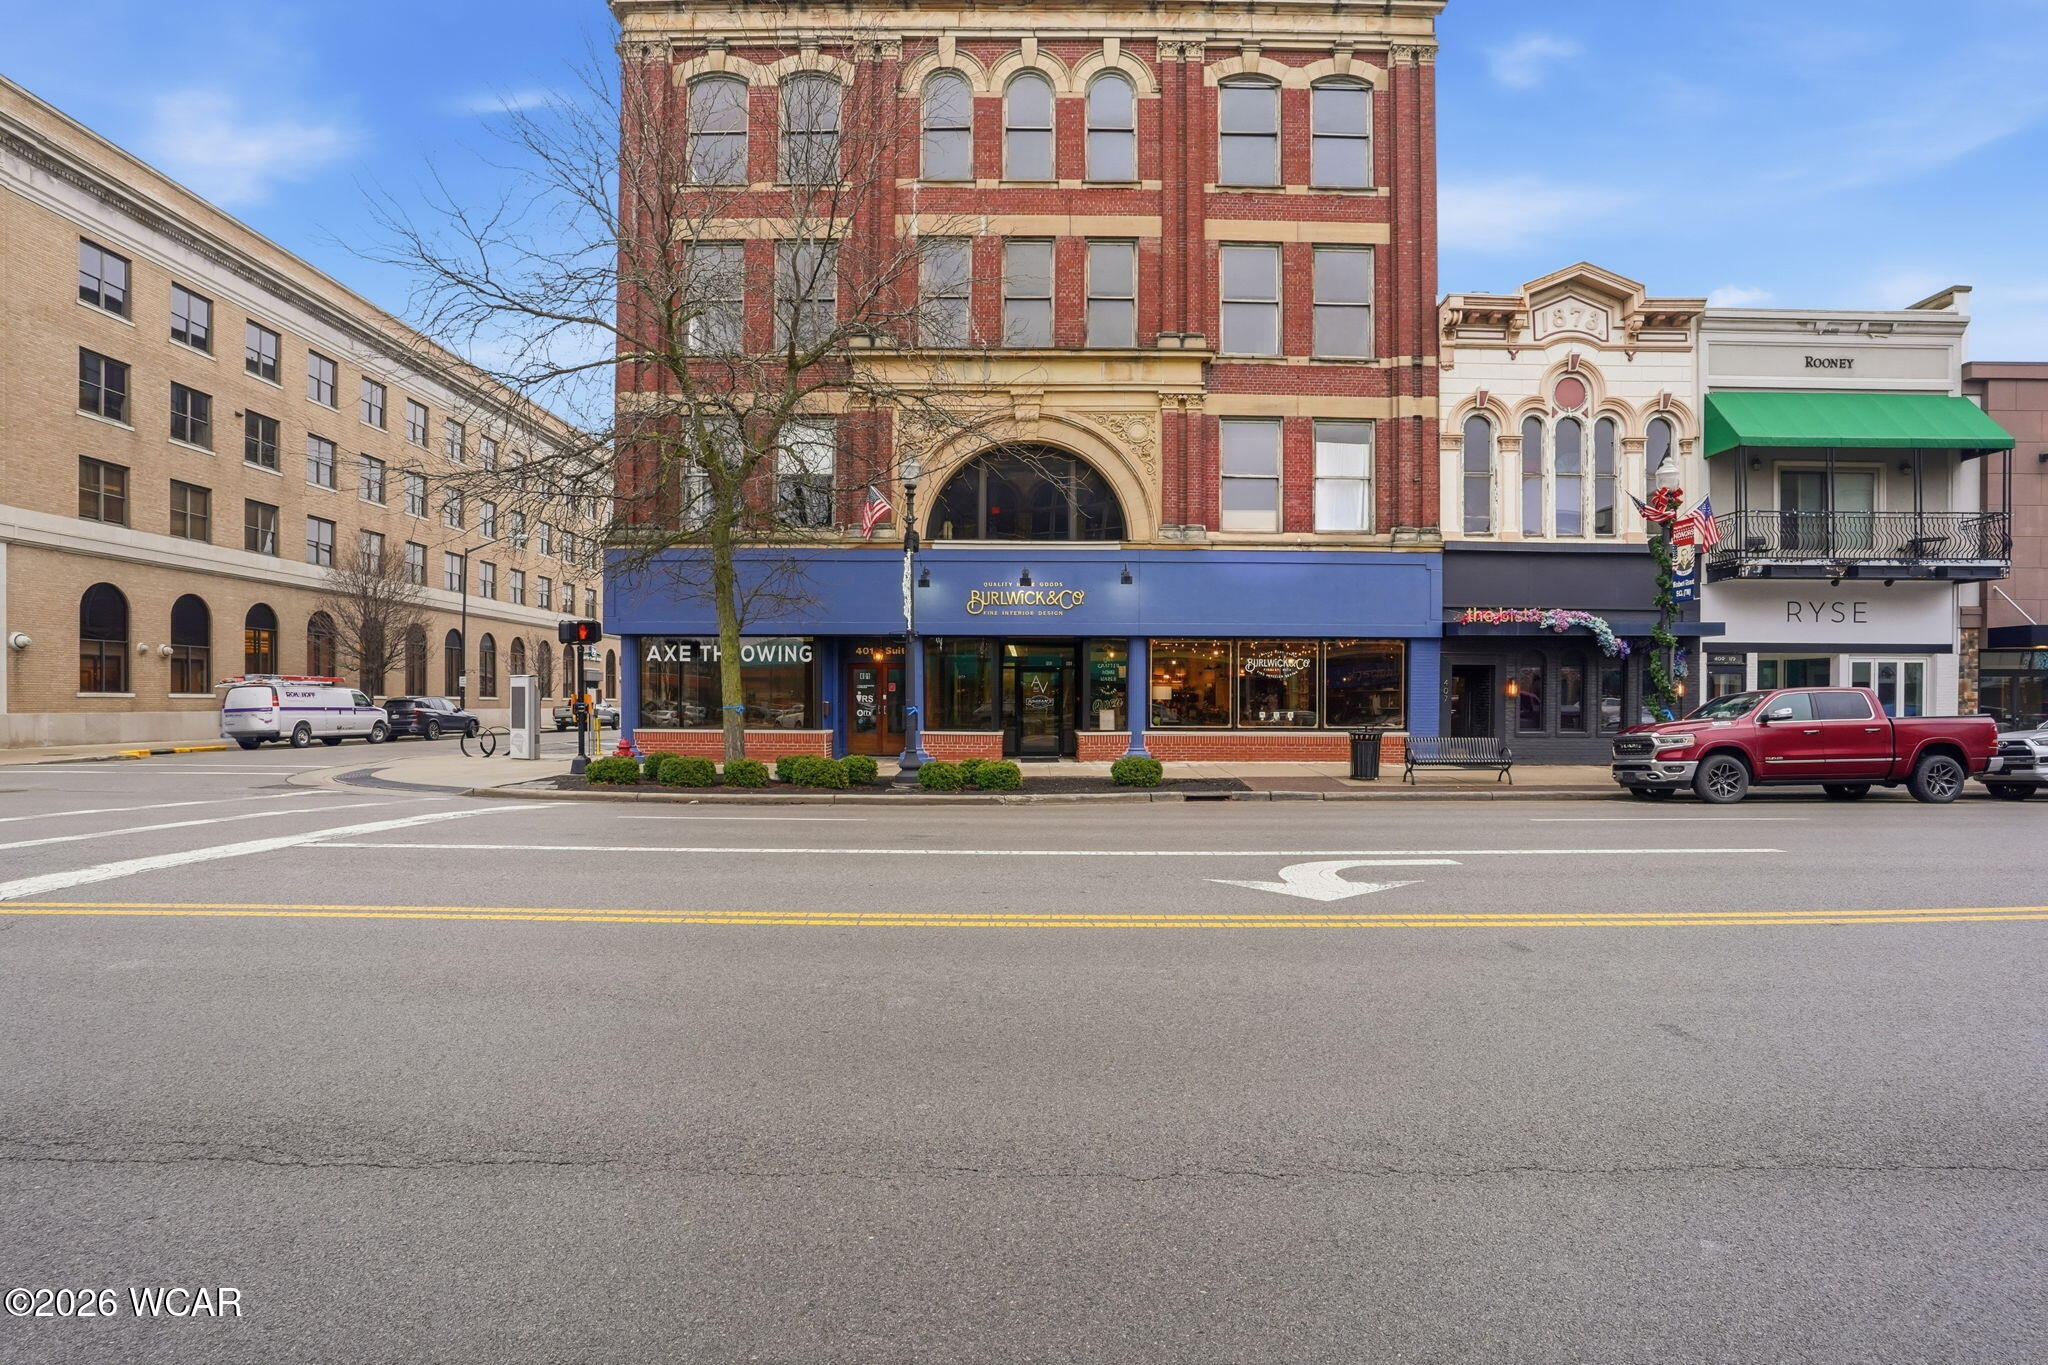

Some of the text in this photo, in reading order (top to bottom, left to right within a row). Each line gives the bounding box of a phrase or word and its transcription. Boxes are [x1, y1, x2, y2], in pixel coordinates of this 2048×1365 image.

[1804, 355, 1855, 369] ROONEY
[1466, 607, 1545, 623] the bisto
[1786, 601, 1868, 623] RYSE
[646, 645, 813, 662] AXE THOWING
[855, 646, 906, 655] 401 Suit
